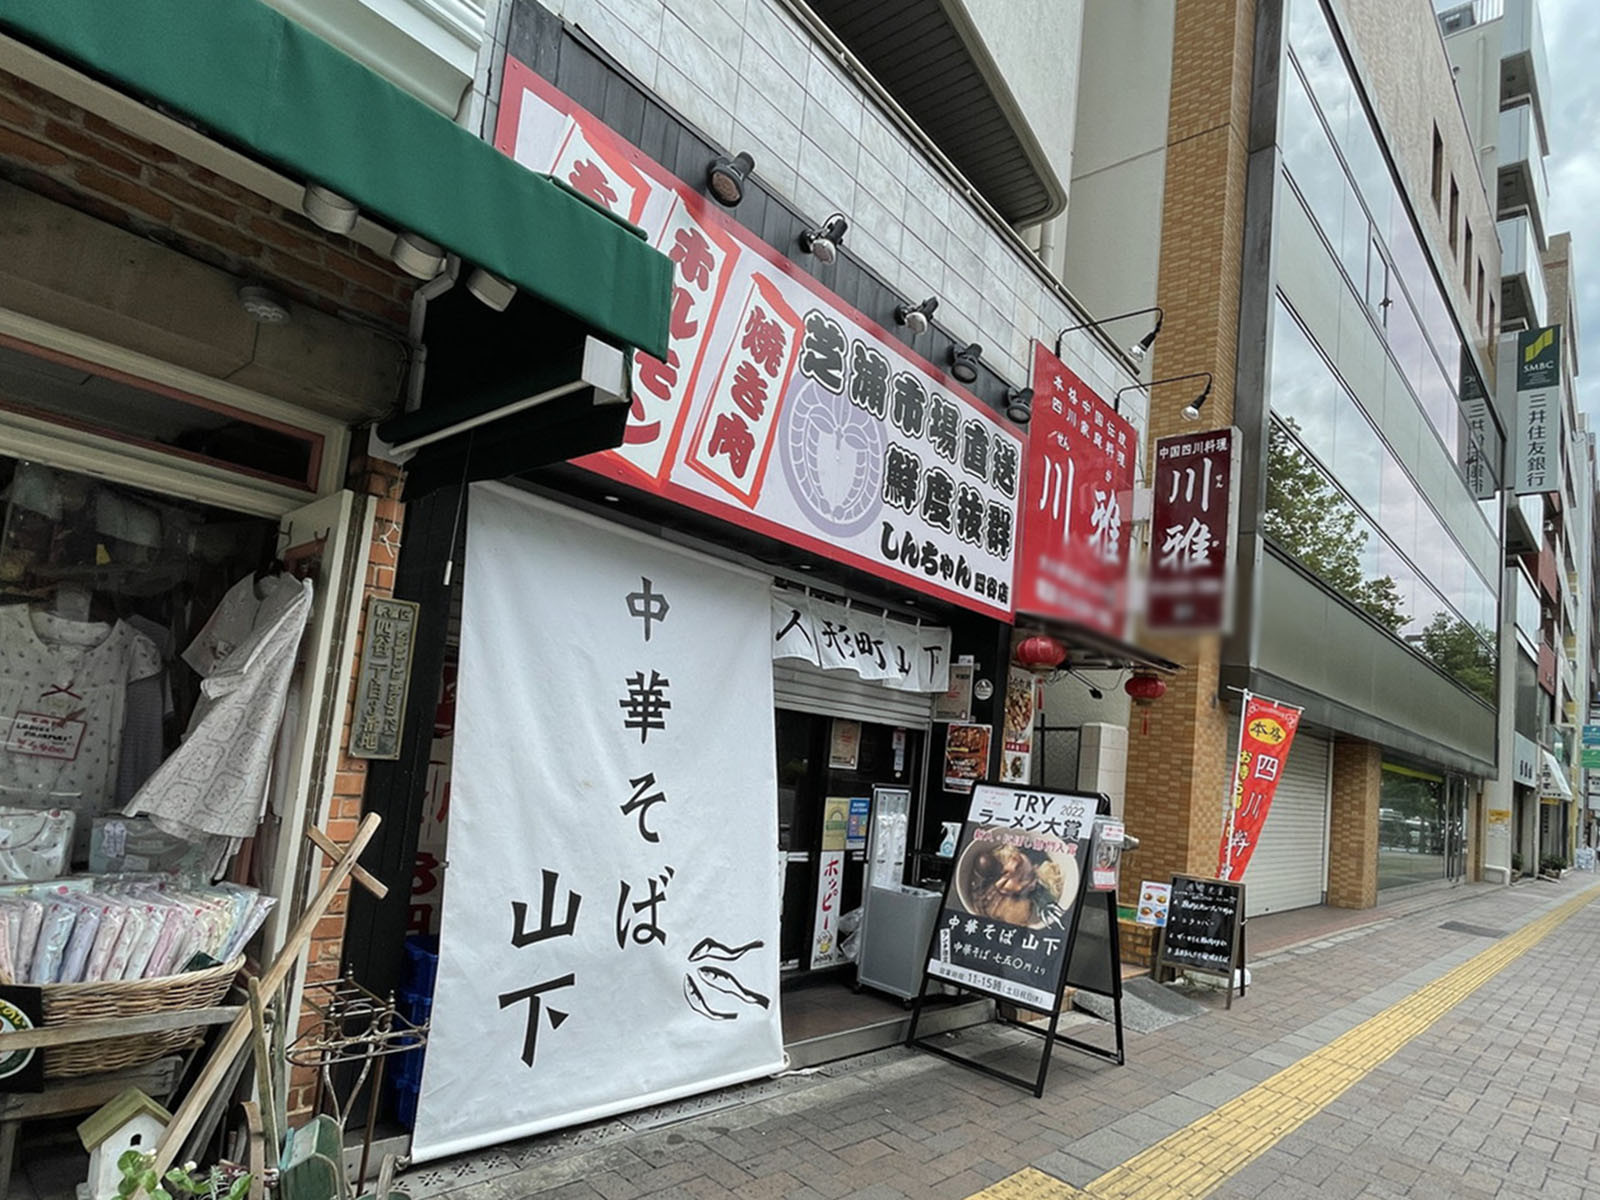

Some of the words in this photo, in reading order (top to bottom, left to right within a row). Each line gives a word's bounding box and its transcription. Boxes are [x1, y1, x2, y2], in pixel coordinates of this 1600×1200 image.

[708, 305, 788, 479] 焼き肉
[1523, 360, 1555, 374] SMBC
[800, 309, 1018, 500] 芝浦市場直送
[1527, 393, 1548, 487] 三井住友銀行
[1158, 437, 1228, 460] 中国四川料理
[882, 442, 1013, 560] 鮮度抜群
[880, 521, 971, 589] しんちゃん
[618, 575, 675, 950] 中華そば
[979, 808, 1082, 841] ラーメン大賞
[1013, 792, 1055, 815] TRY
[1060, 805, 1086, 818] 2022
[821, 859, 840, 931] ホッピー
[498, 867, 583, 1068] 山下
[953, 941, 991, 960] 中華そば
